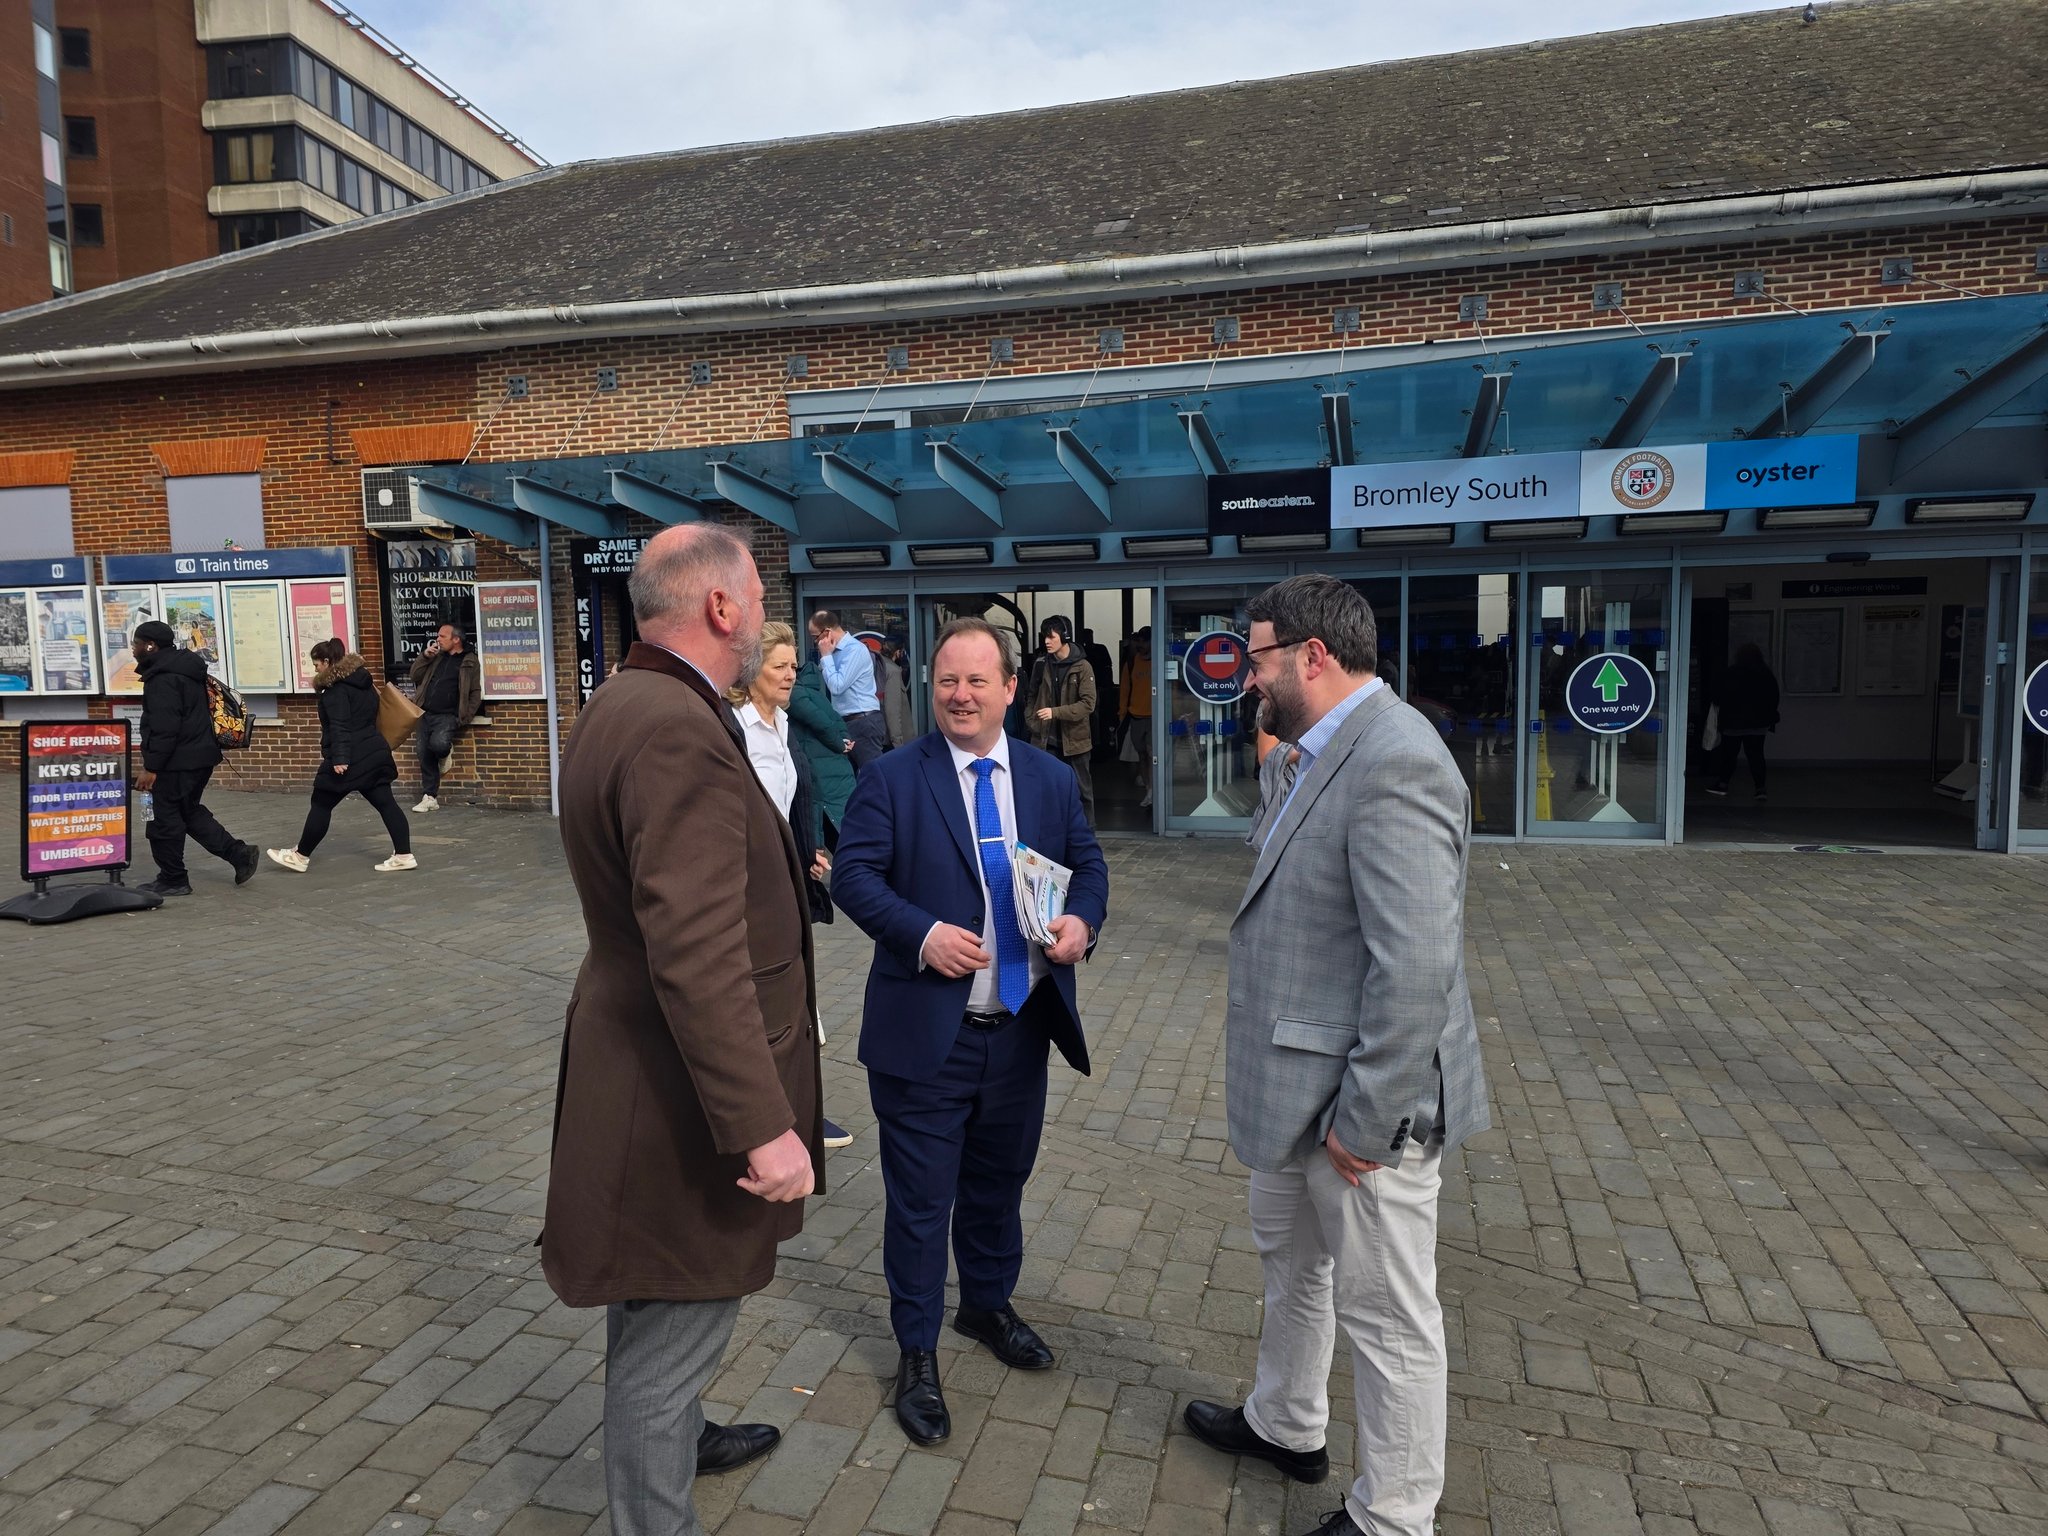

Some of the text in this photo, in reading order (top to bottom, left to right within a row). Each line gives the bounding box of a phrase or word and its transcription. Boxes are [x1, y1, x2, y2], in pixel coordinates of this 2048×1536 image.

[1613, 453, 1672, 490] BROMLEY FOOTBALL CLUB
[1736, 462, 1820, 488] oyster
[1354, 474, 1547, 508] Bromley South
[598, 539, 637, 551] SAME
[583, 552, 611, 565] DRY
[200, 557, 269, 573] Train times
[611, 565, 631, 573] 10AM
[392, 571, 425, 584] SHOE
[395, 587, 421, 599] KEY
[482, 595, 535, 604] SHOE REPAIRS
[412, 602, 439, 610] Batteries
[412, 611, 432, 619] Straps
[577, 598, 591, 641] KEY
[413, 620, 436, 628] Repairs
[487, 616, 534, 628] KEYS CUT
[400, 640, 423, 655] Dry
[508, 656, 540, 665] BATTERIES
[492, 681, 536, 691] UMBRELLAS
[1219, 681, 1236, 691] only
[1581, 703, 1640, 714] One way only
[33, 735, 121, 748] SHOE REPAIRS
[38, 762, 118, 778] KEYS CUT
[32, 790, 122, 804] DOOR ENTRY FOBS
[31, 812, 124, 827] WATCH BATTERIES
[52, 824, 103, 835] & STRAPS
[40, 844, 114, 861] UMBRELLAS
